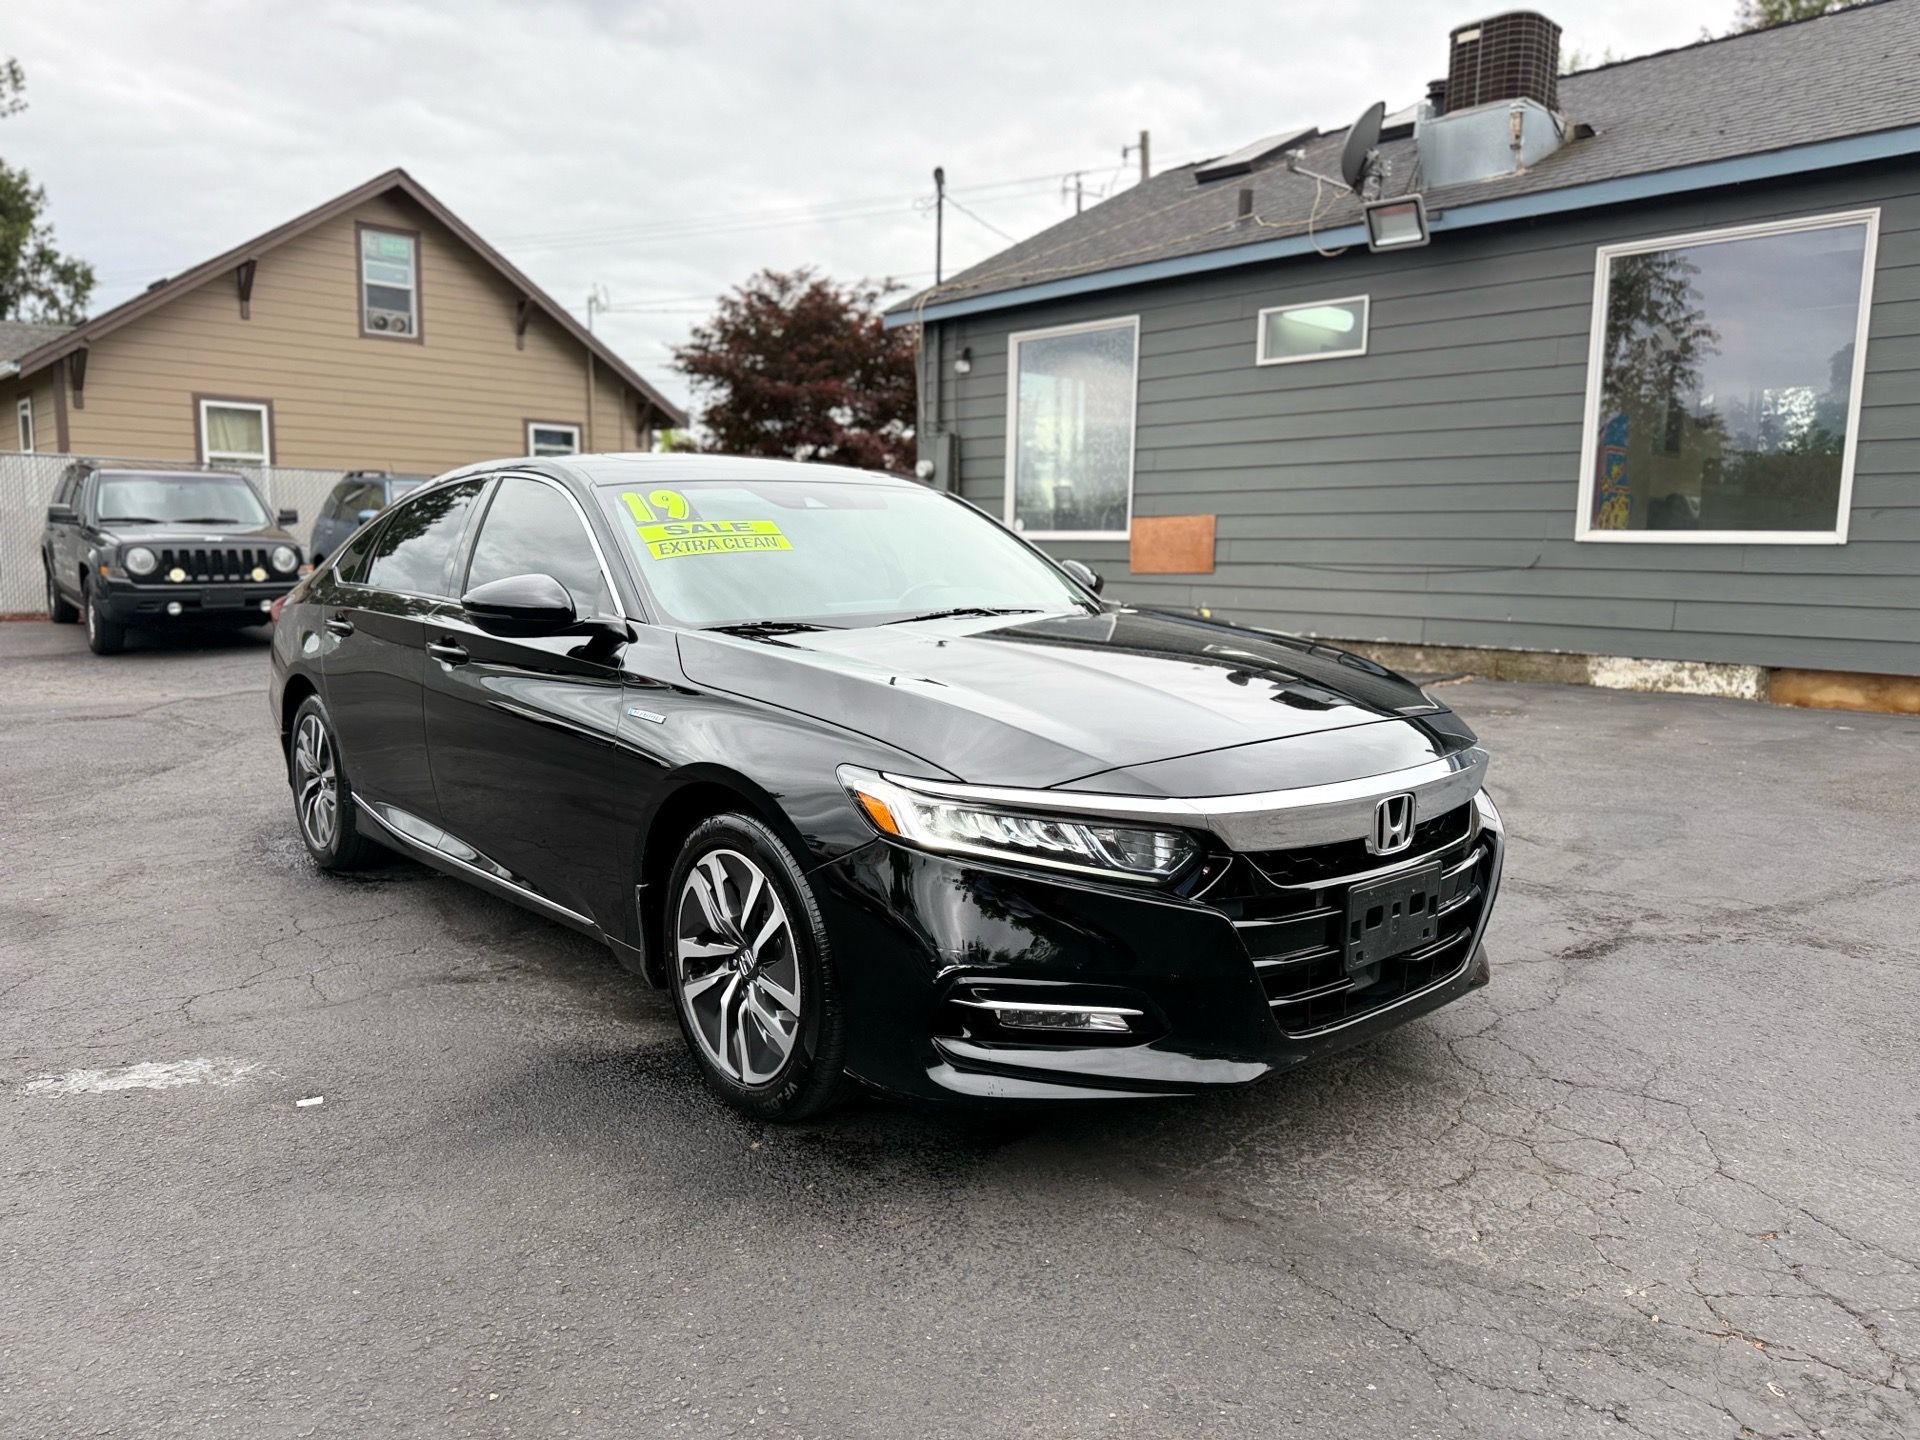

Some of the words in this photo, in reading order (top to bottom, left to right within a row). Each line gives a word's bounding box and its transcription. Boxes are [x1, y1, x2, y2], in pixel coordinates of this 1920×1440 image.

[622, 490, 690, 522] 19
[663, 522, 754, 535] SALE
[658, 538, 720, 555] EXTRA
[722, 536, 778, 550] CLEAN
